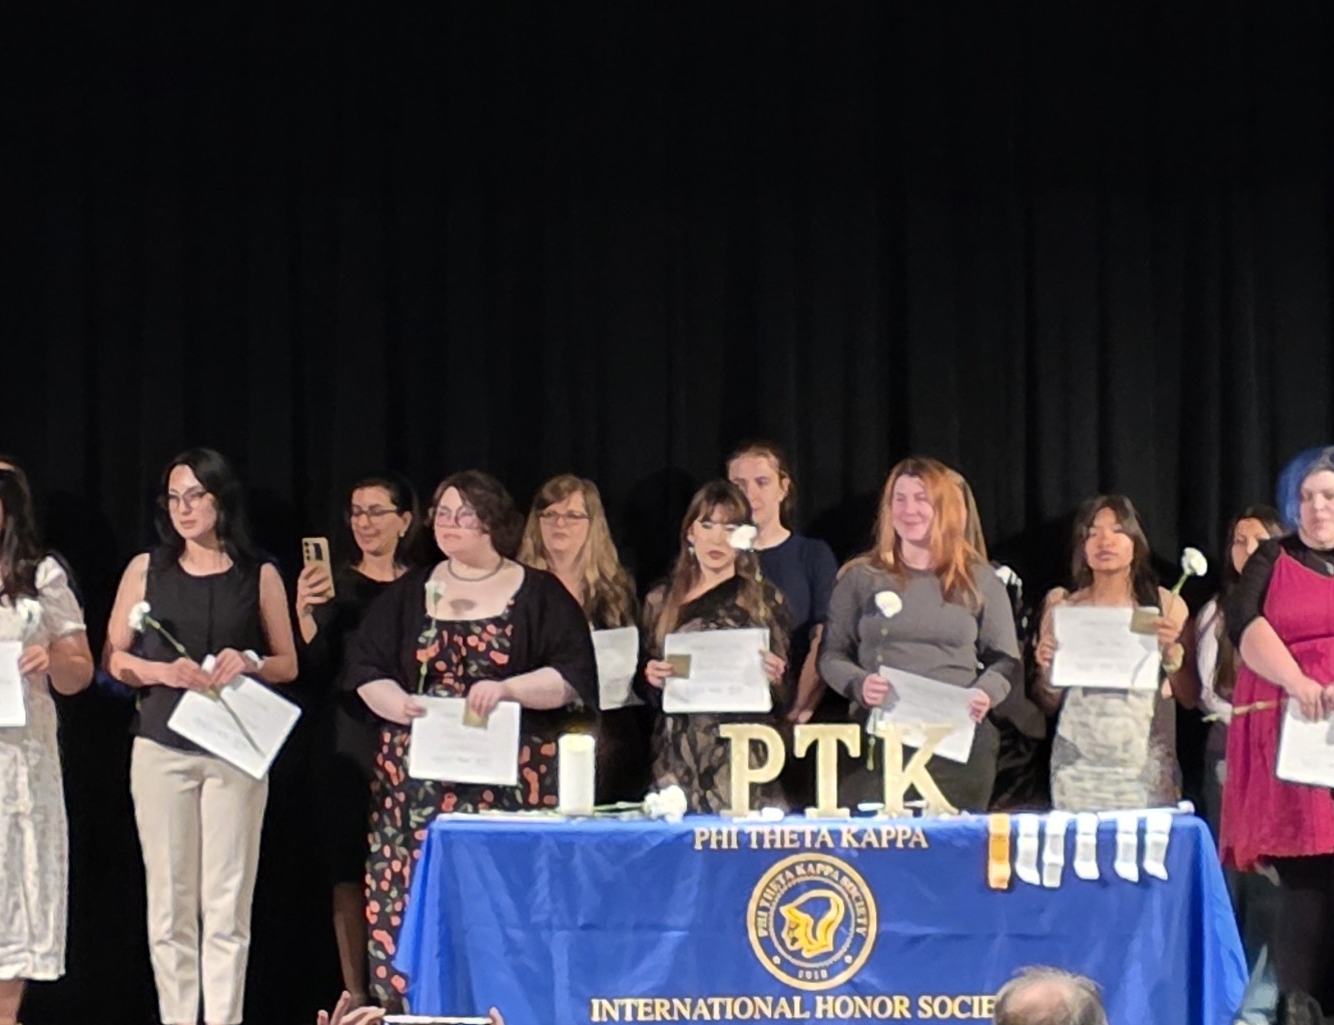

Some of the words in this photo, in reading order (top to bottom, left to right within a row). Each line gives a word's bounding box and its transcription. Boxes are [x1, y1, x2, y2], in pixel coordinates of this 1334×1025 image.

[719, 723, 959, 820] PTK
[694, 827, 738, 849] PHI
[744, 826, 835, 849] THETA
[840, 826, 929, 849] KAPPA
[590, 997, 809, 1022] INTERNATIONAL
[815, 997, 909, 1020] HONOR
[917, 995, 996, 1019] SOCIE
